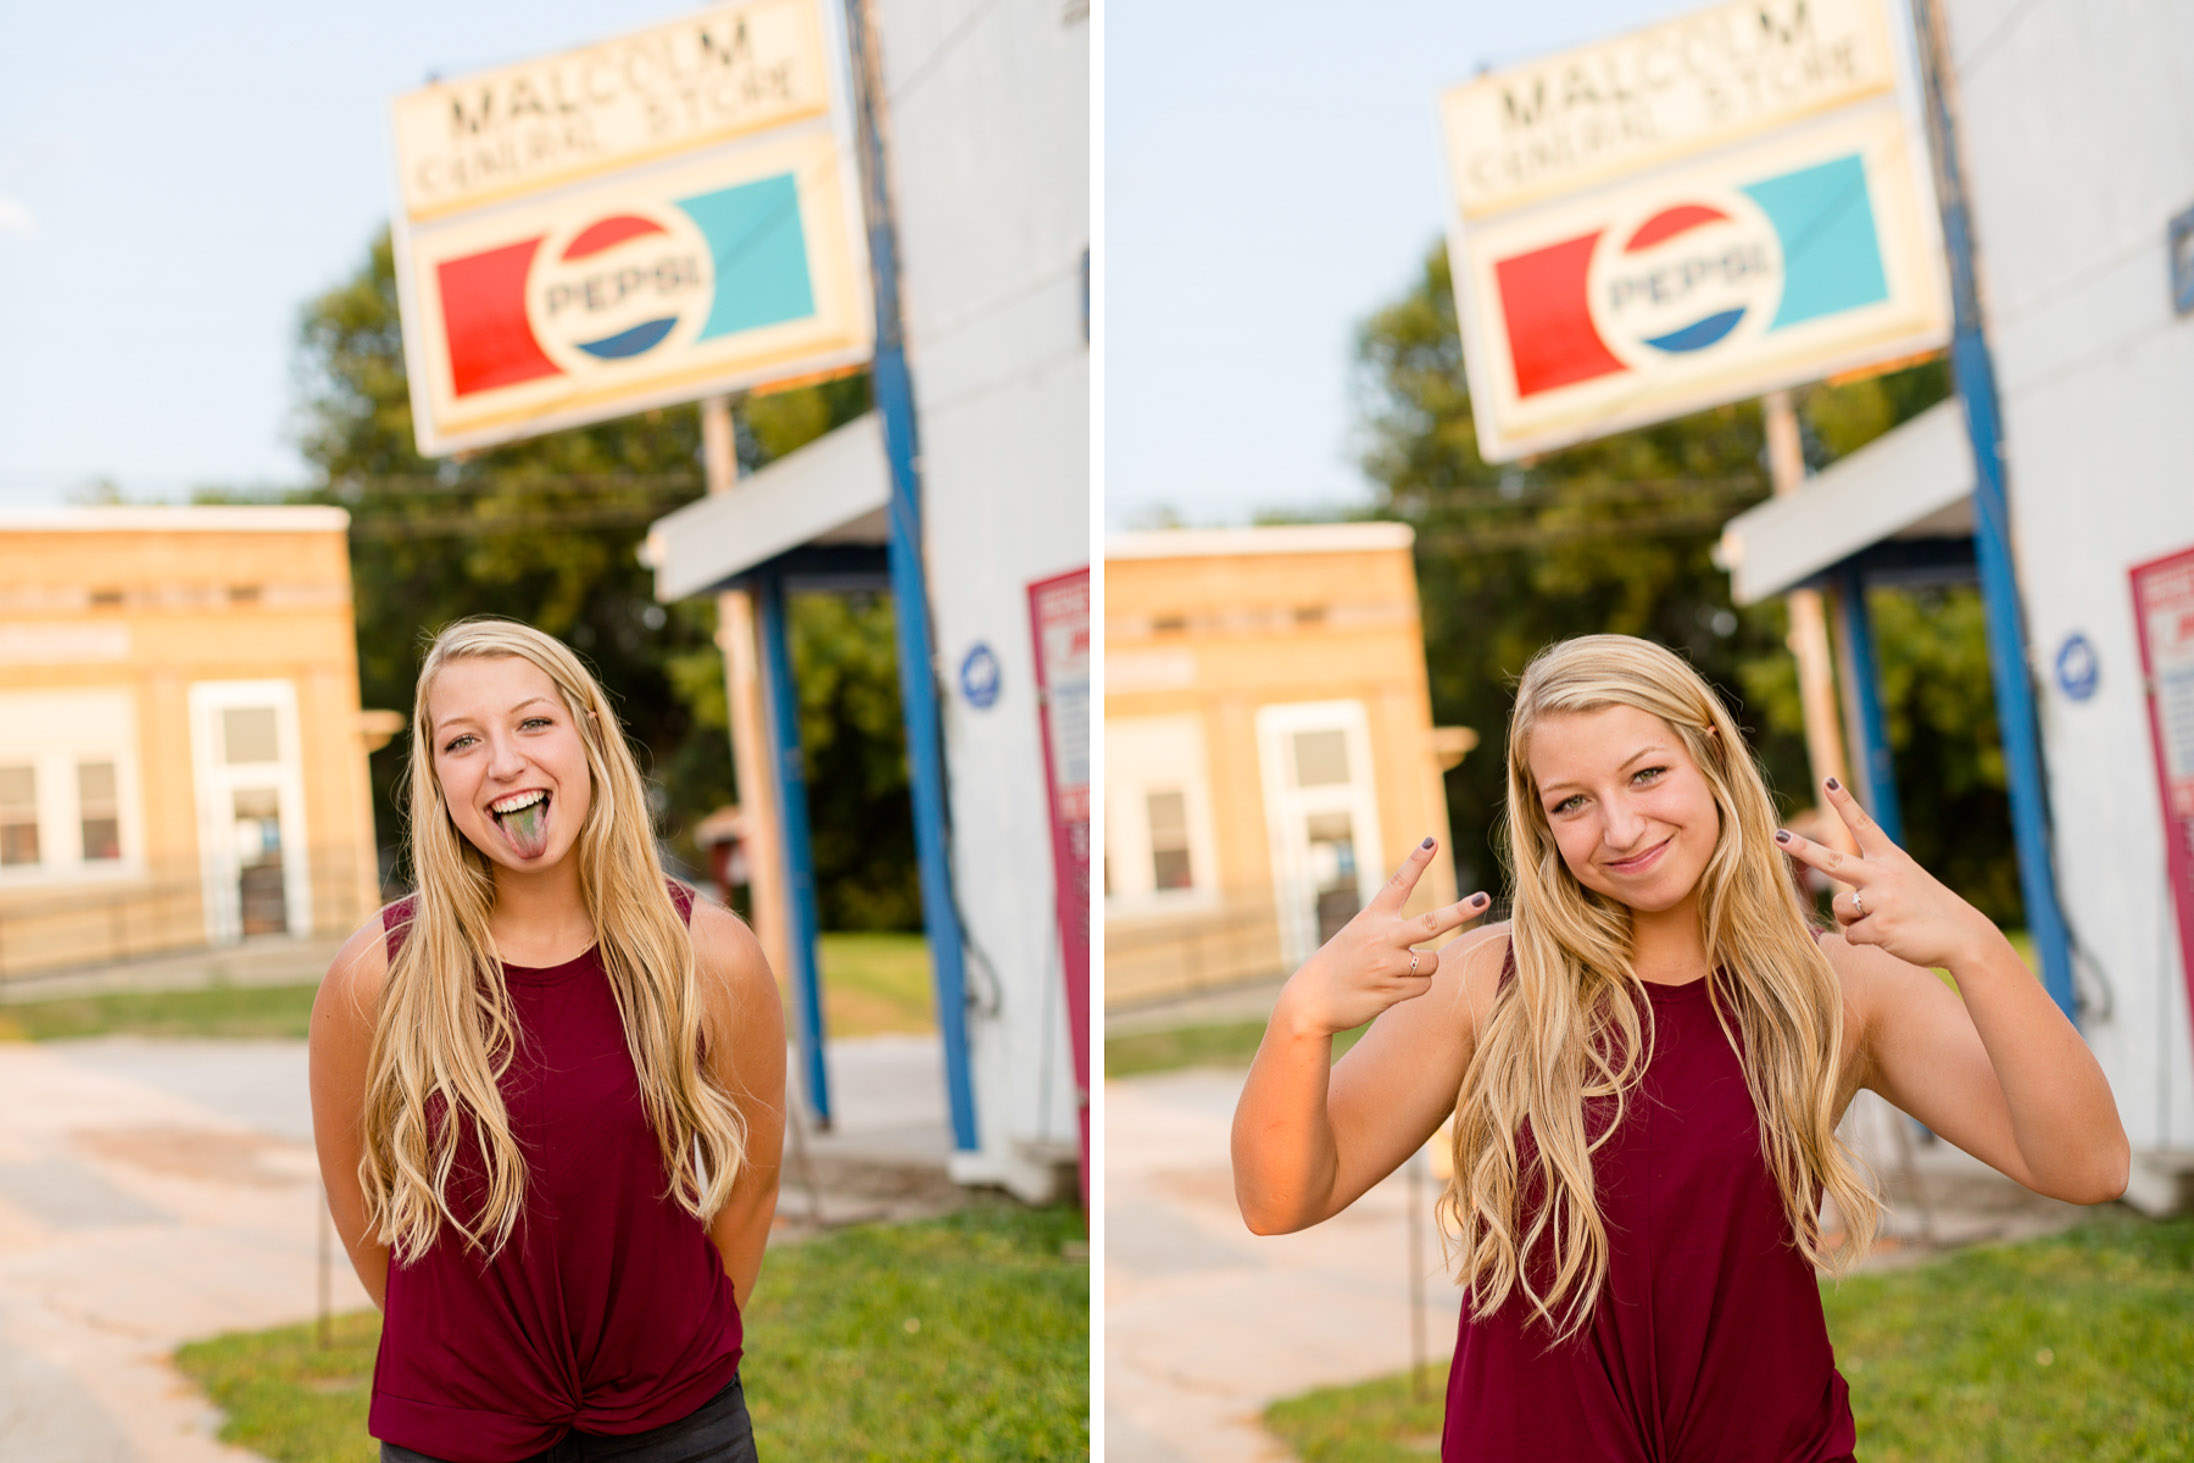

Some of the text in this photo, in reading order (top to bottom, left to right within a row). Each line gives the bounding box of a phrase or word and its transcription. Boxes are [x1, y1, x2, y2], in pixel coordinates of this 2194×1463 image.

[449, 10, 755, 139] MALCOLM
[645, 54, 799, 134] STORE
[1499, 0, 1811, 130] MALCOLM
[545, 252, 704, 320] PEPSI
[1608, 240, 1772, 314] PEPSI
